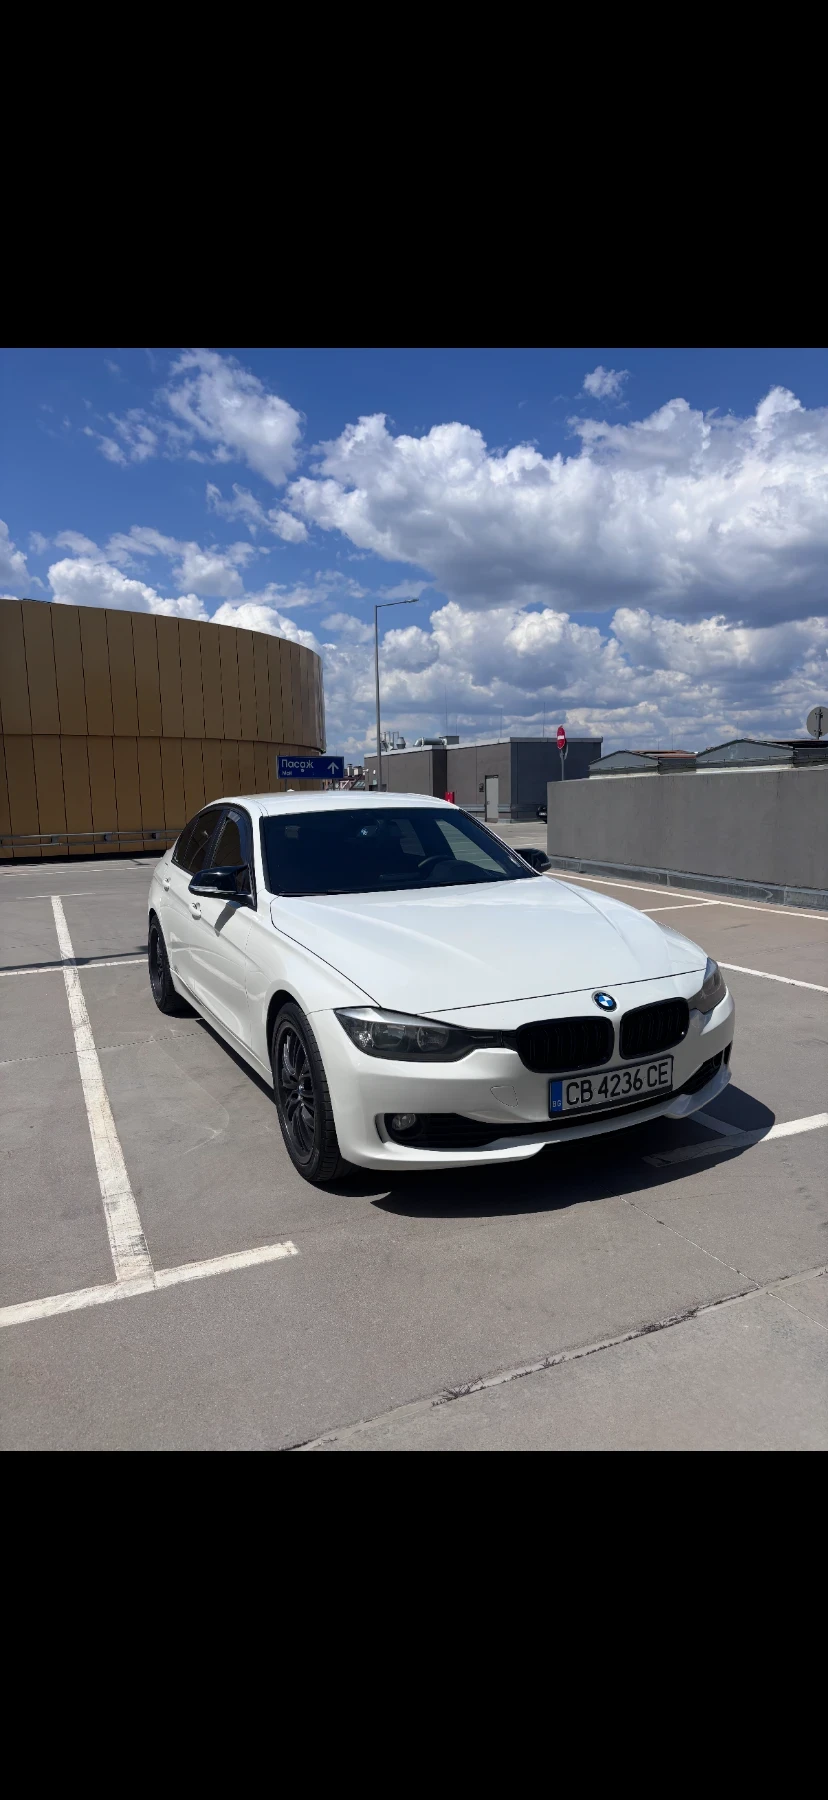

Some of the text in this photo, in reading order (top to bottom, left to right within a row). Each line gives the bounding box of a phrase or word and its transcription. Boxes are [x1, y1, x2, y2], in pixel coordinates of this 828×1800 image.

[282, 759, 314, 768] Пасаж
[566, 1062, 668, 1105] CB 4236 CE
[552, 1100, 561, 1108] BG
